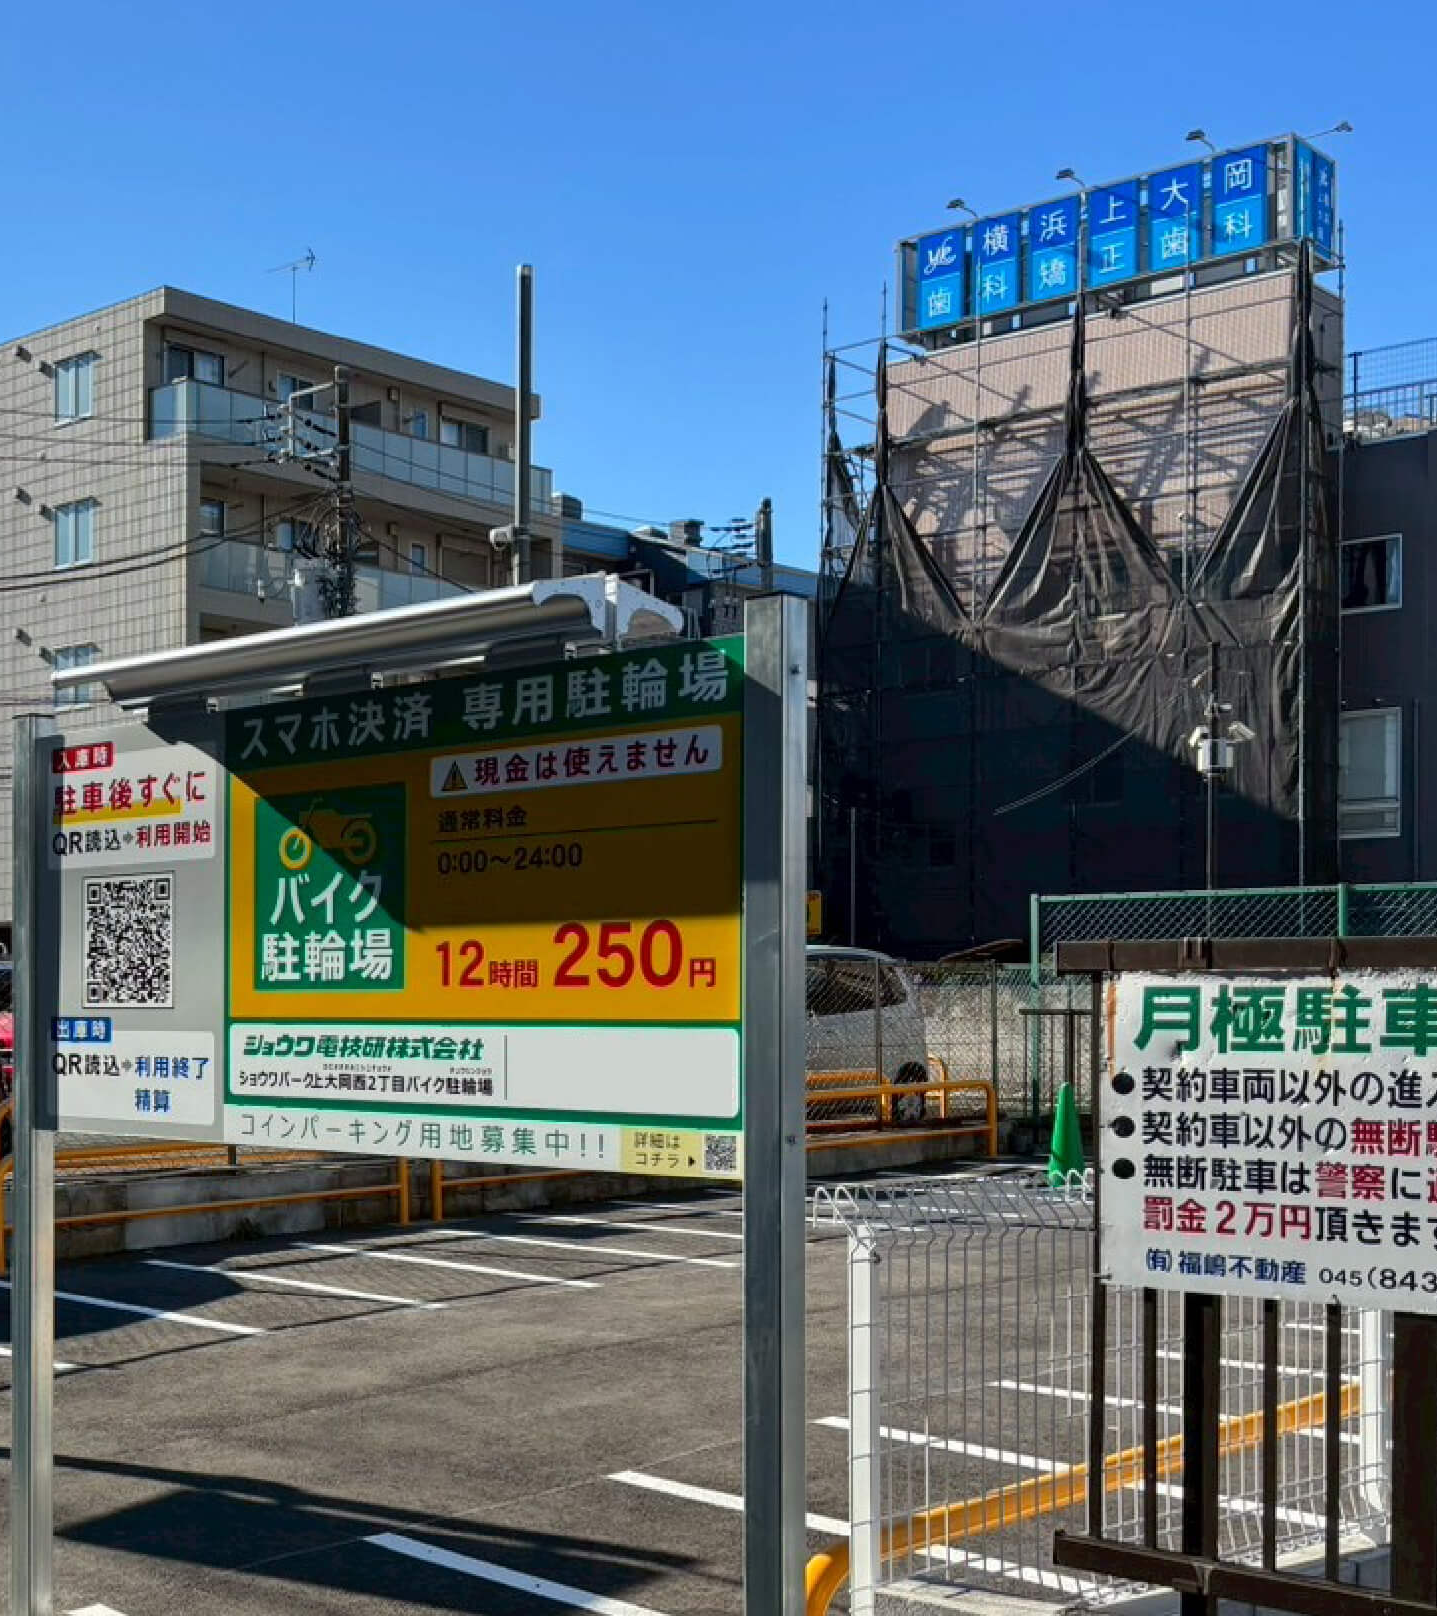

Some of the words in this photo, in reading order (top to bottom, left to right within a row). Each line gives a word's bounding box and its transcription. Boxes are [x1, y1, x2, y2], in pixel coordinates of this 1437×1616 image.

[240, 693, 434, 760] スマホ決済
[462, 651, 729, 730] 専用駐輪場
[474, 734, 709, 786] 現金は使えません
[53, 771, 206, 817] 駐車後すぐに
[438, 805, 528, 833] 通常料金
[270, 870, 382, 924] バイク
[262, 928, 393, 981] 駐輪場
[436, 939, 539, 988] 12時間
[553, 919, 716, 988] 250円
[1133, 984, 1437, 1057] 月極駐車
[243, 1034, 485, 1061] ショウワ電技研株式会社
[633, 1131, 681, 1150] 詳細は
[1141, 1109, 1437, 1157] 契約車以外の無断
[635, 1153, 681, 1169] コチラ
[1142, 1153, 1437, 1204] 無断駐車は警察に
